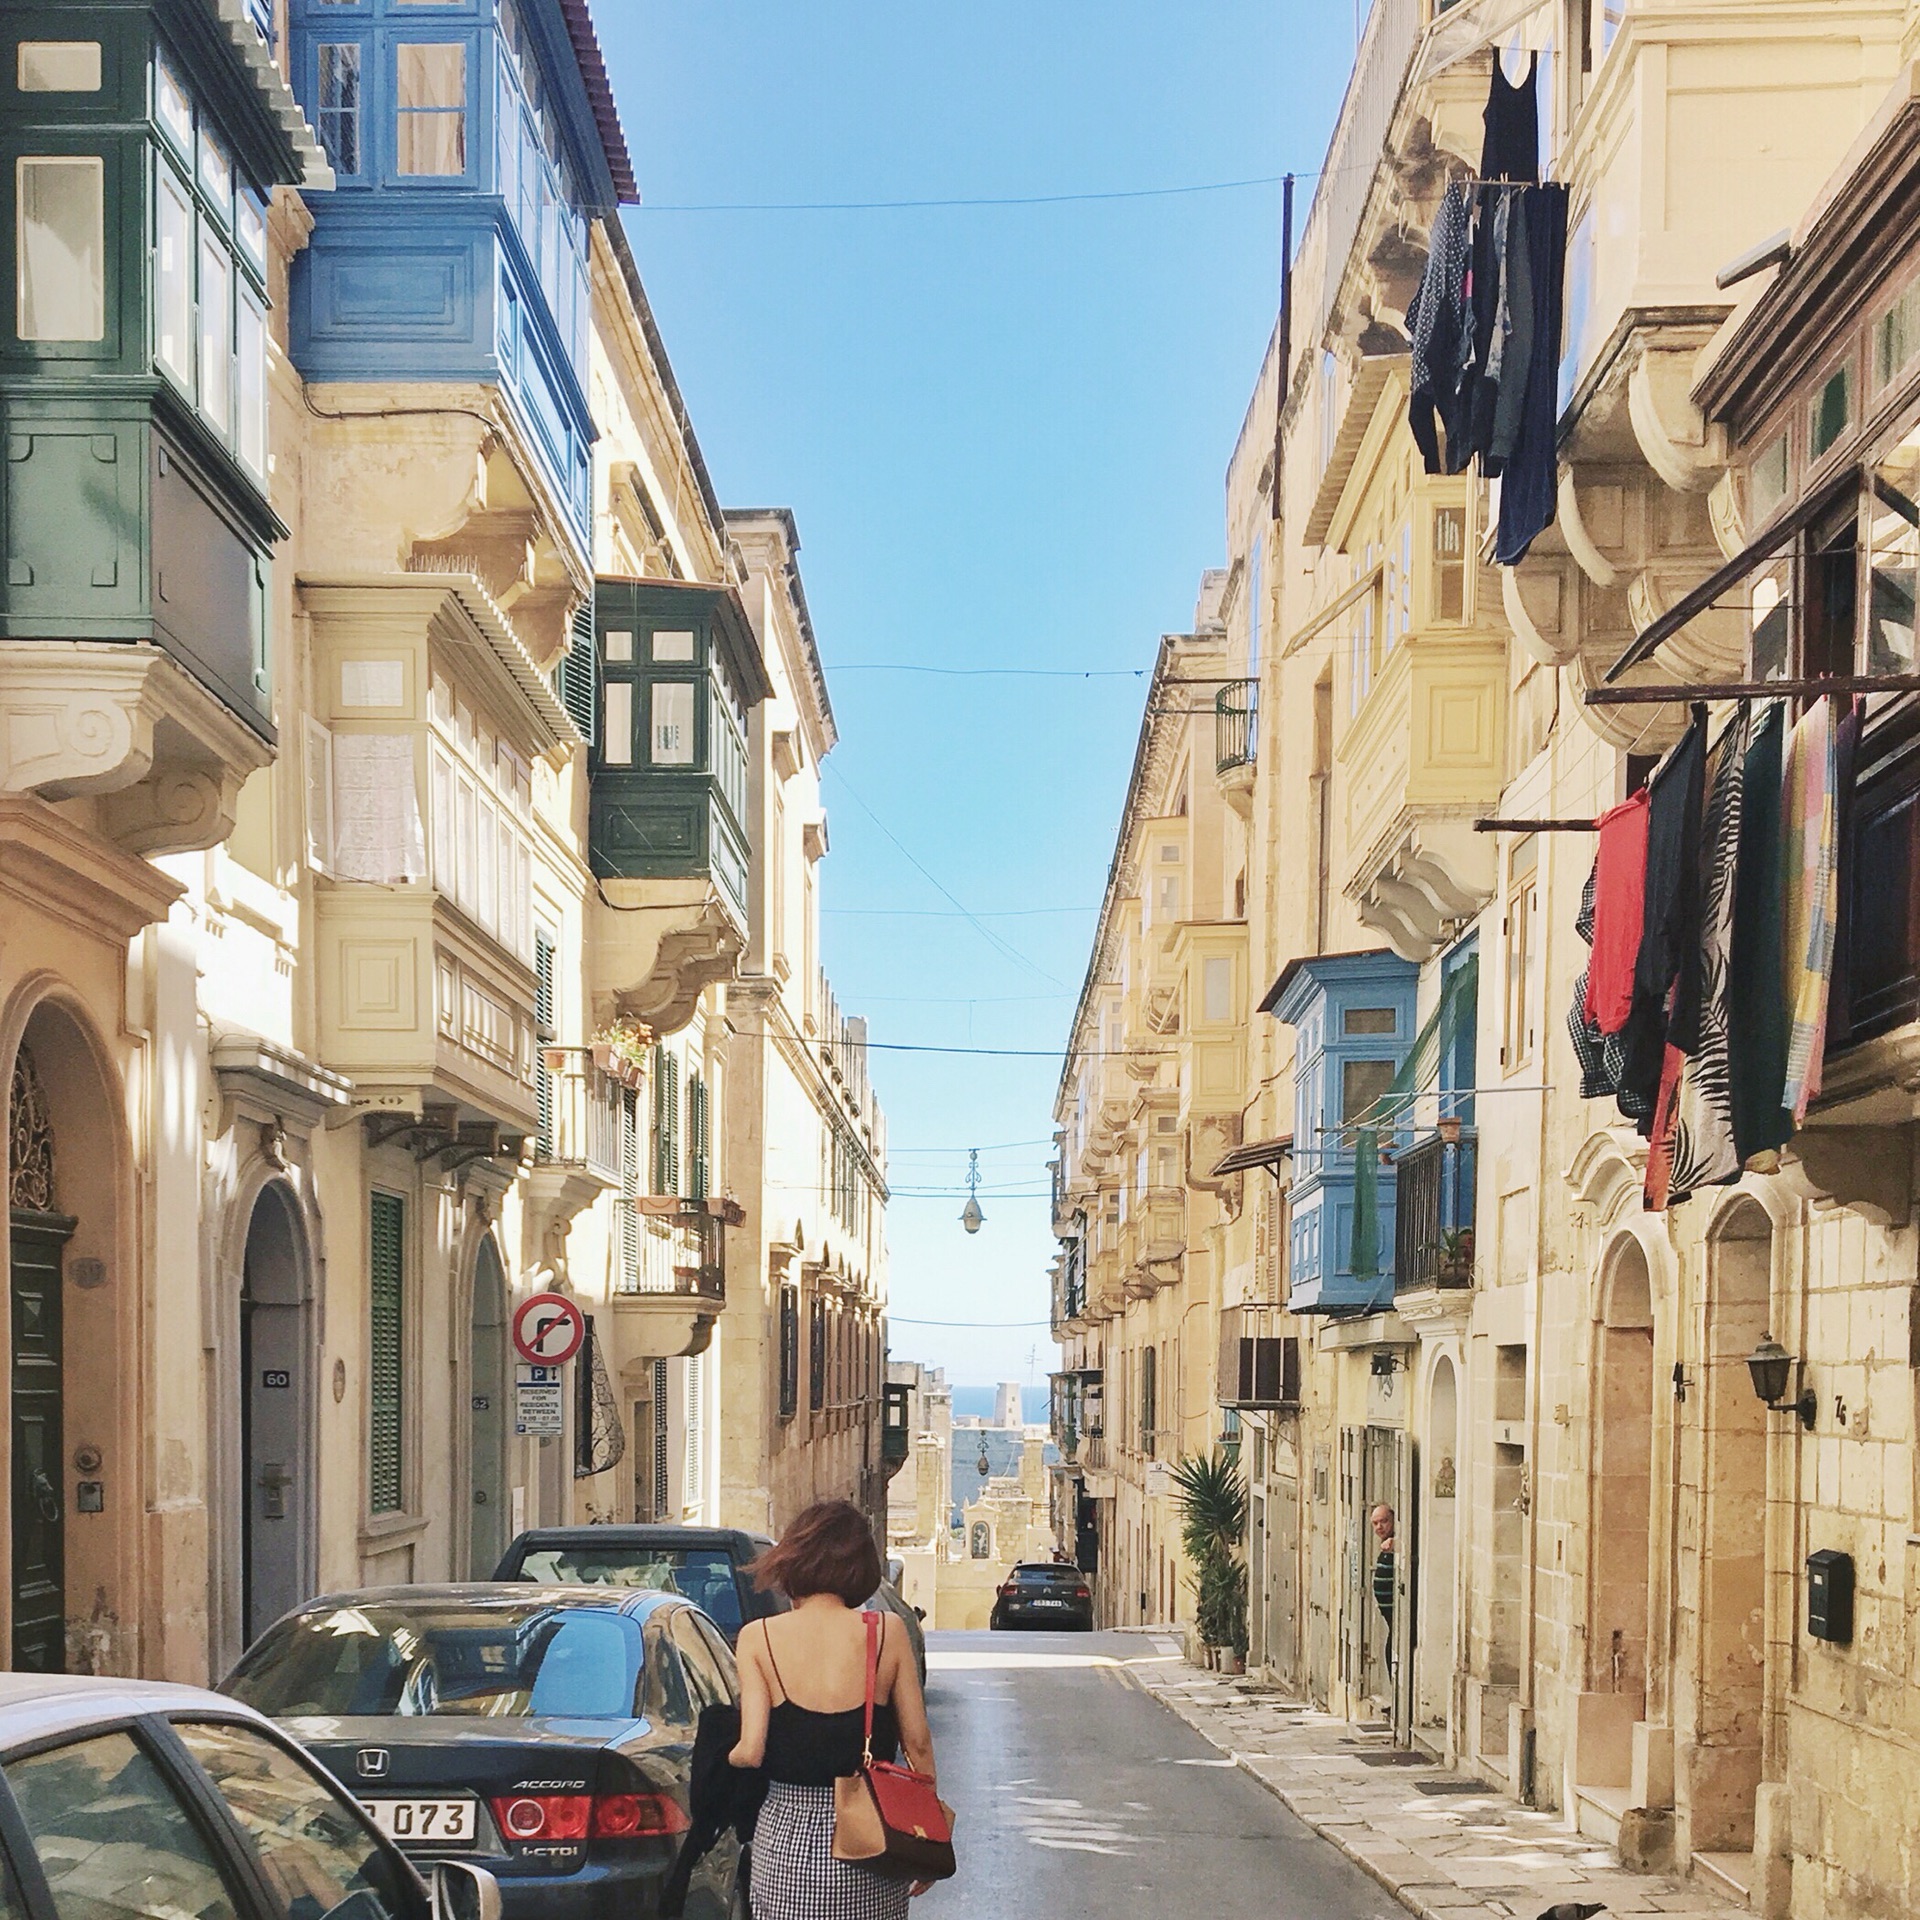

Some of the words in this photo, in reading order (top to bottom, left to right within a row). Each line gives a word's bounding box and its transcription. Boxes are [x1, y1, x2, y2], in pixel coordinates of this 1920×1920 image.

[266, 1373, 287, 1385] 60
[534, 1368, 543, 1379] P
[472, 1399, 488, 1409] 62
[1834, 1395, 1847, 1426] 76
[512, 1780, 586, 1789] ACCORD
[394, 1804, 463, 1835] 073
